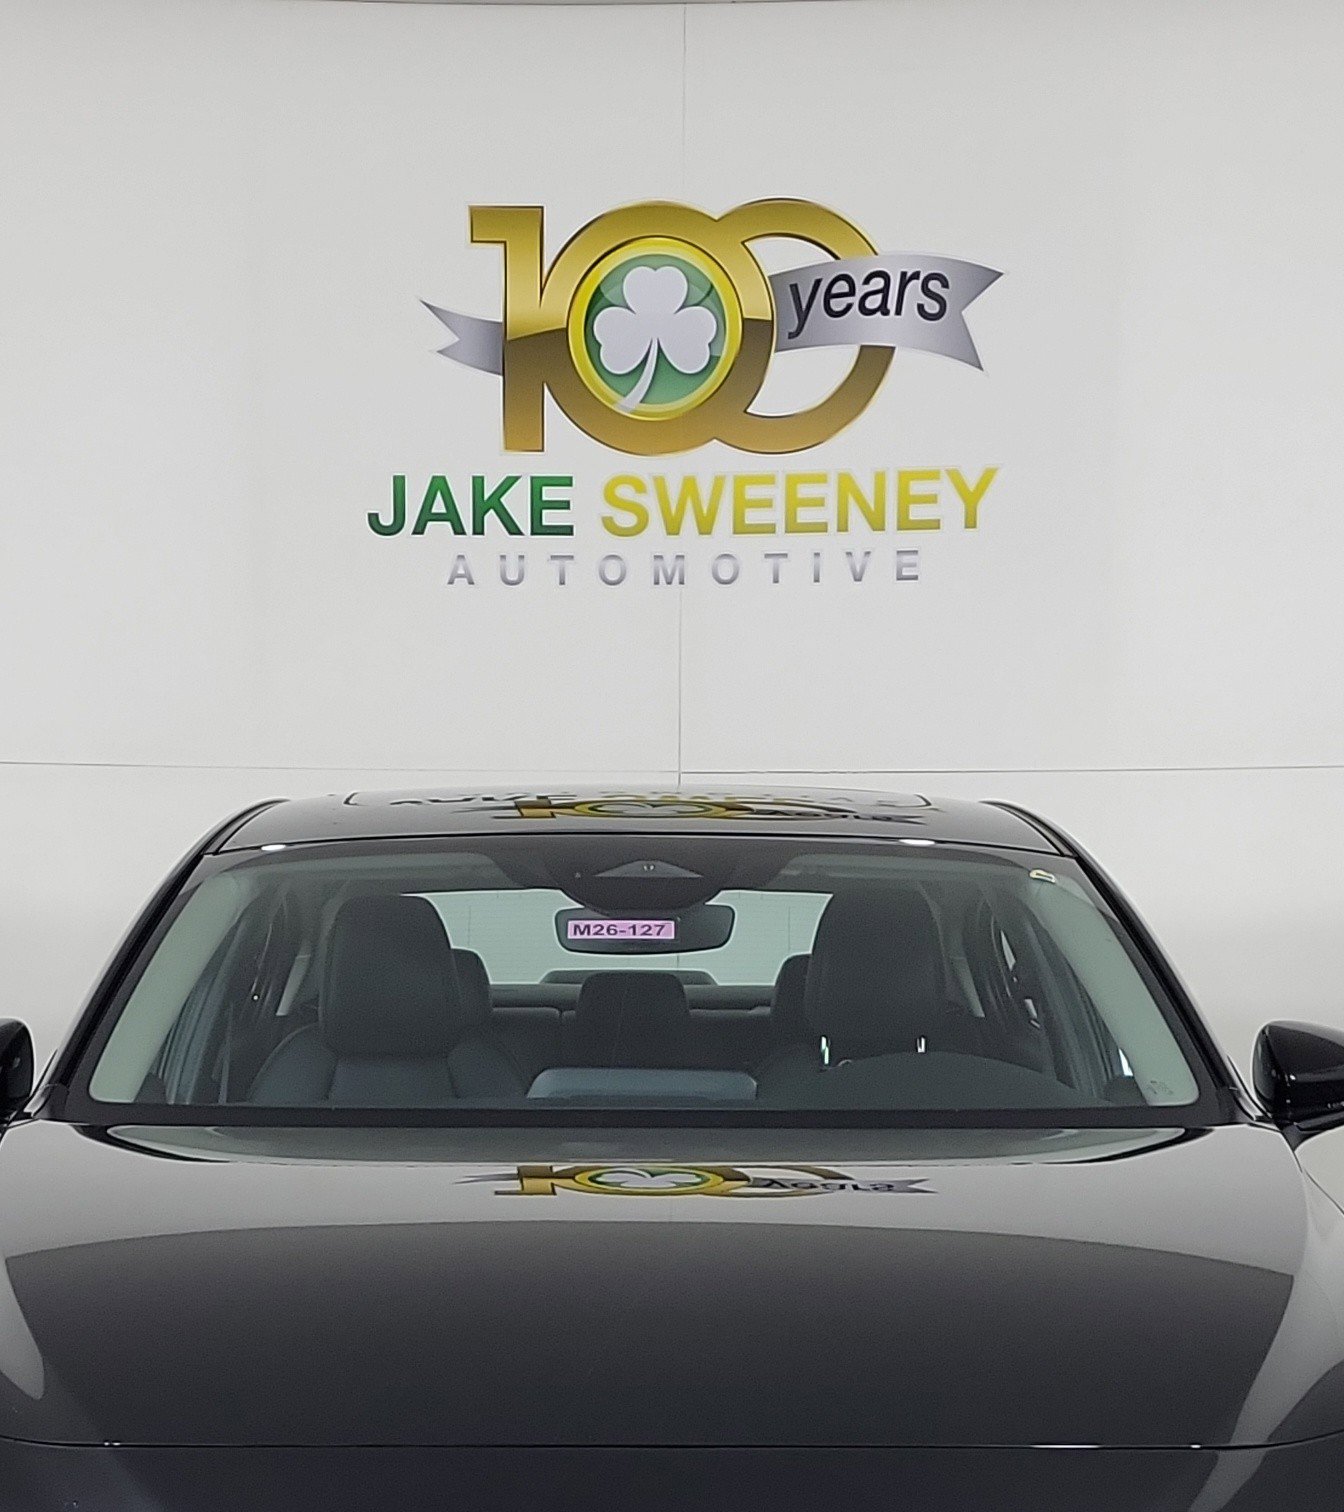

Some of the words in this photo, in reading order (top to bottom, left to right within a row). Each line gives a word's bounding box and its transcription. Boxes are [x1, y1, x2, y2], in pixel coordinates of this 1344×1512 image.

[468, 197, 895, 456] 100
[786, 267, 950, 339] years
[367, 474, 574, 536] JAKE
[601, 467, 998, 537] SWEENEY
[447, 549, 920, 586] AUTOMOTIVE
[573, 924, 666, 936] M26-127
